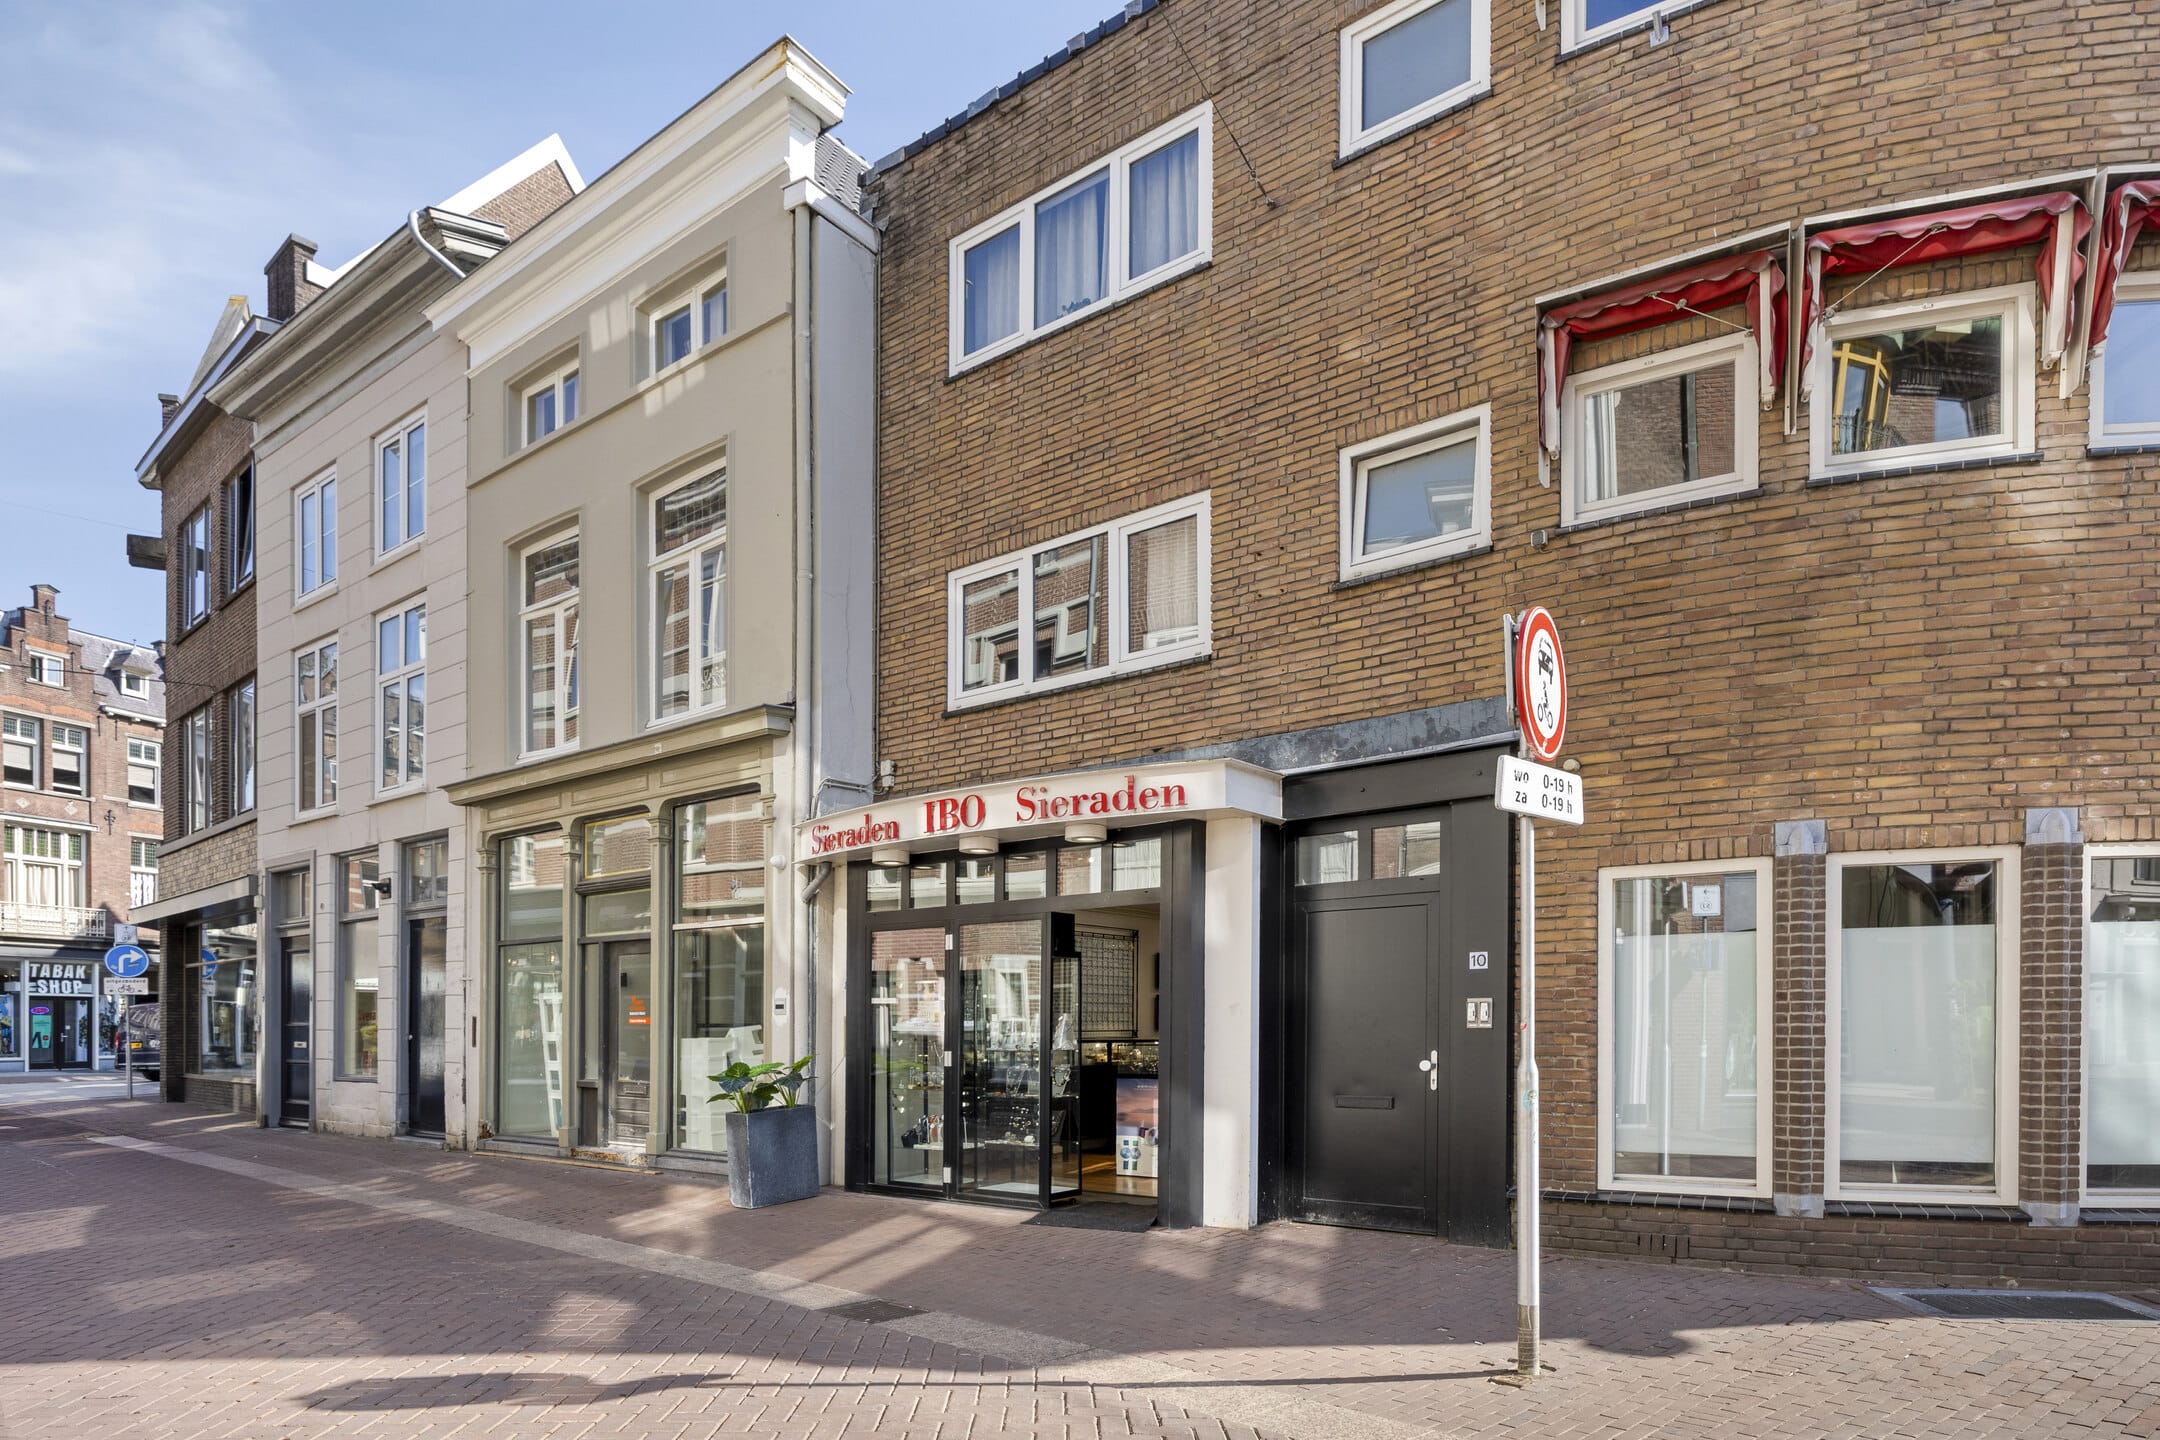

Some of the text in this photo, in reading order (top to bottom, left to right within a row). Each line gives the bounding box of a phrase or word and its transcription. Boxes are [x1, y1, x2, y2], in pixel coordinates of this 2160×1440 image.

[1513, 769, 1573, 795] wo 0-19 h
[1515, 790, 1573, 814] za 0-19 h
[811, 775, 1186, 855] Sieraden IBO Sieraden
[1470, 953, 1487, 967] 10
[29, 963, 87, 979] TABAK
[37, 979, 83, 994] SHOP
